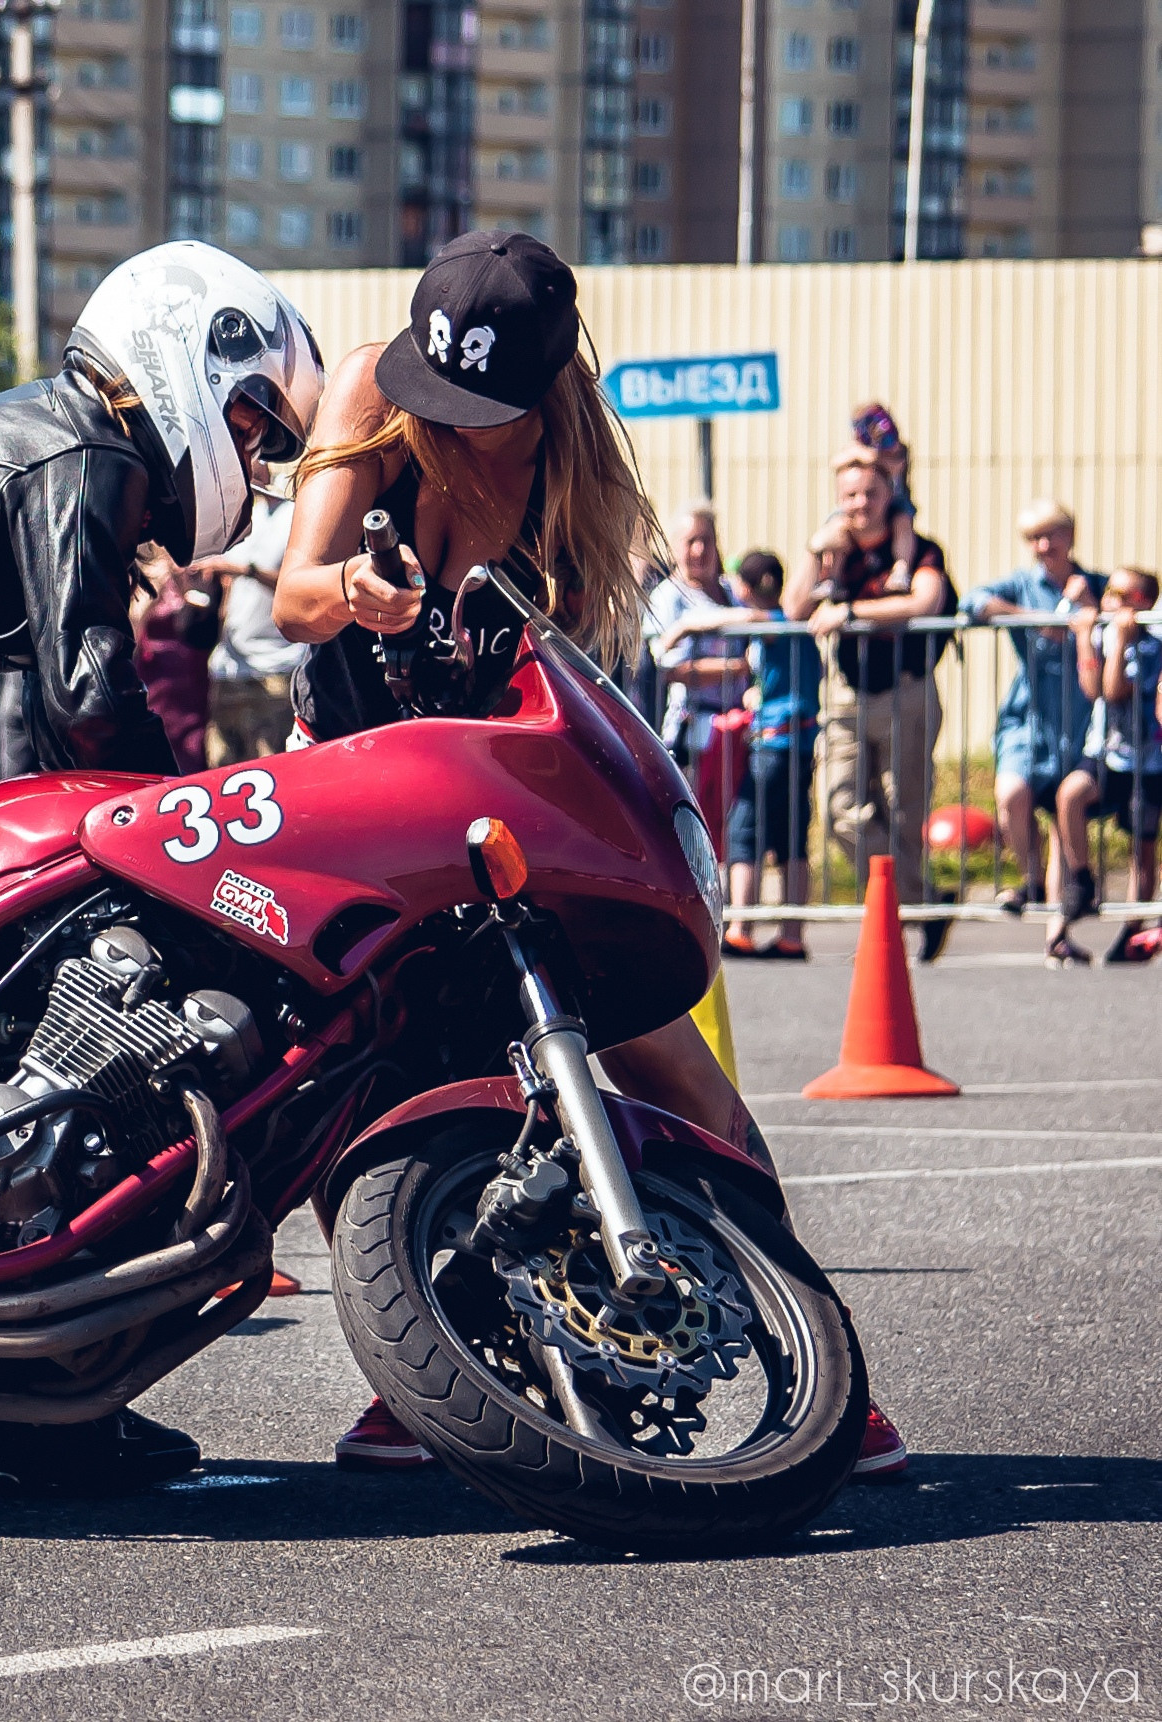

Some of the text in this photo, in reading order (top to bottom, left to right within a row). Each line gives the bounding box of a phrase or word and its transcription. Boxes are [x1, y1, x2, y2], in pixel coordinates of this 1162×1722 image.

[132, 330, 185, 436] SHARK
[620, 362, 771, 407] ВЫЕЗД
[158, 769, 283, 865] 33
[220, 884, 263, 914] GYM
[225, 873, 272, 898] MOTO
[213, 900, 255, 926] RIGA
